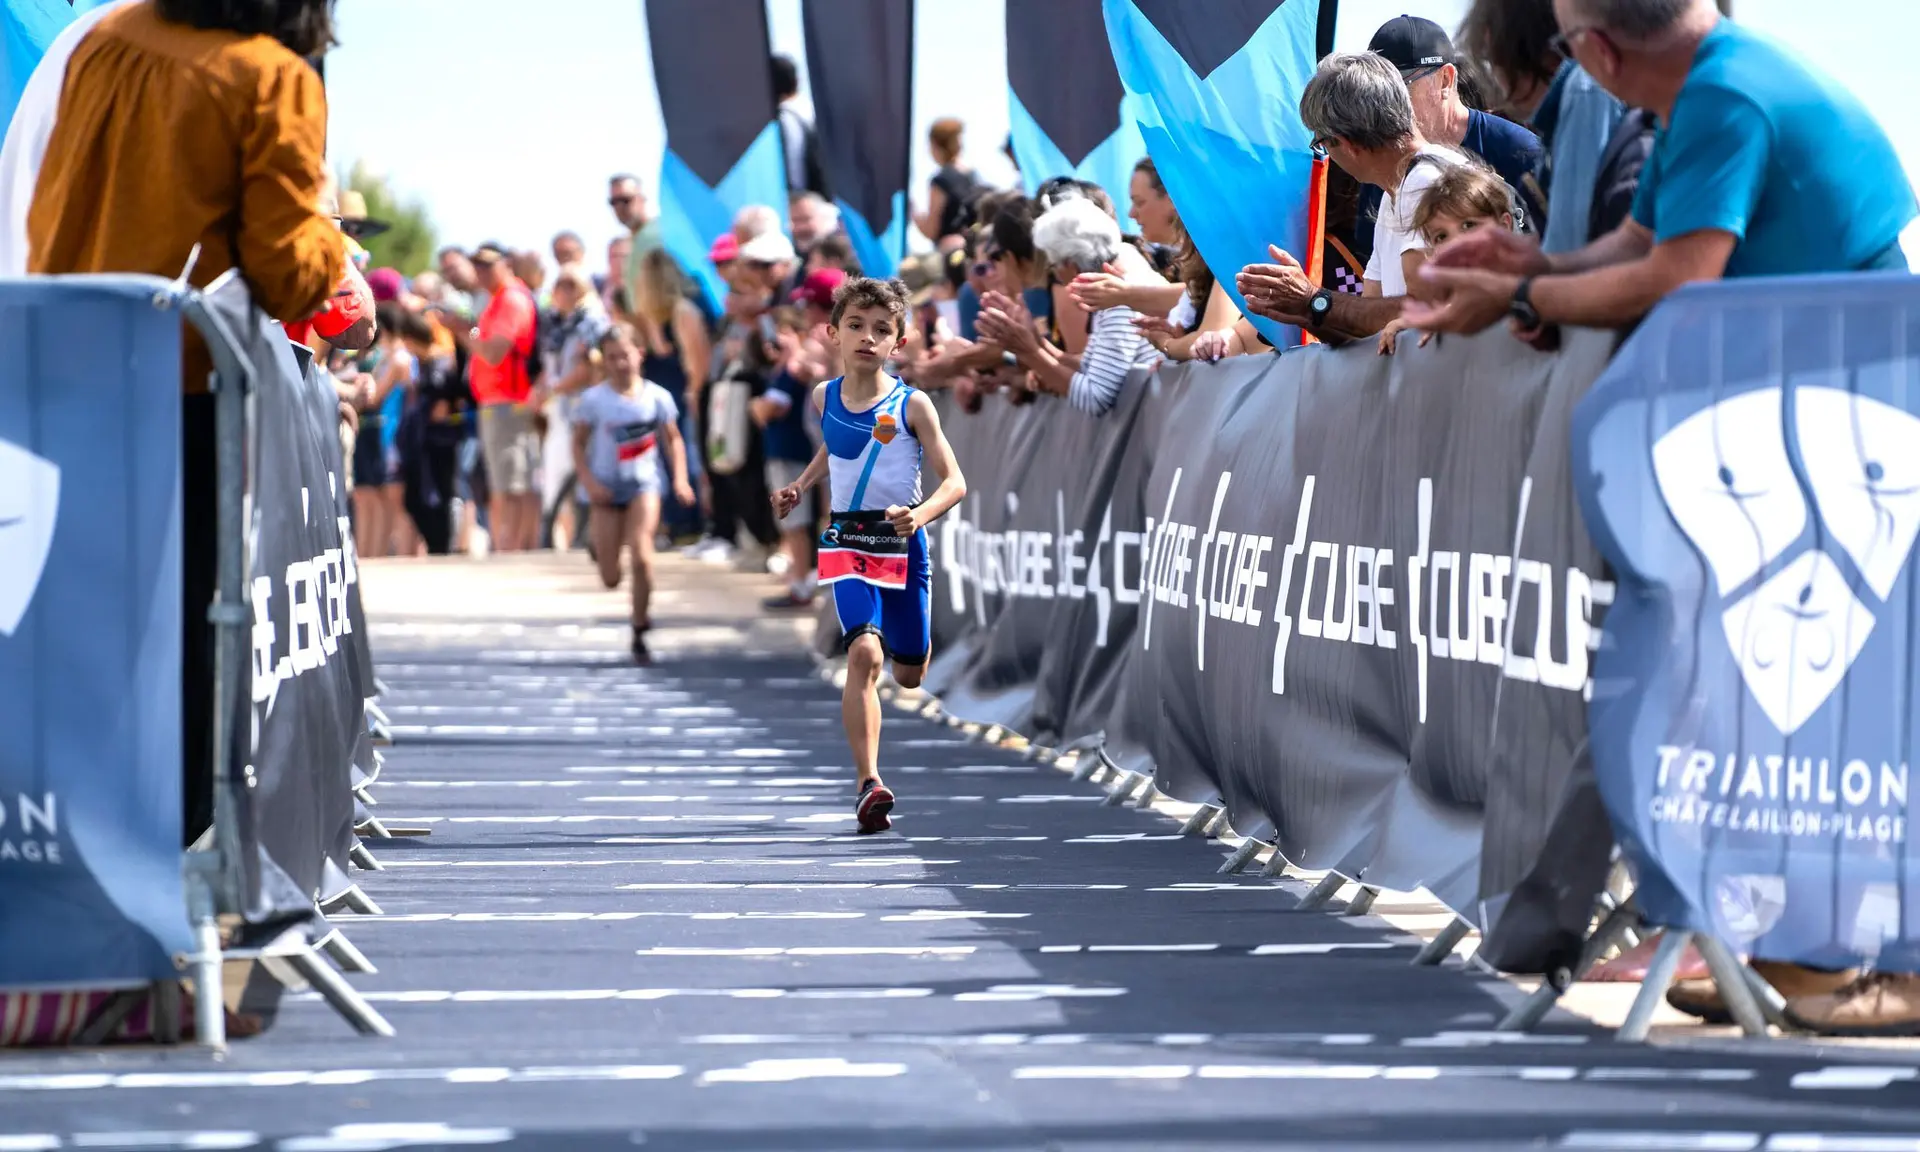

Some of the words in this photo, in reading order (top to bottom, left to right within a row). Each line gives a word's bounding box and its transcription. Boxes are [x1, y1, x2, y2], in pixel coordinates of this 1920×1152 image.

[853, 556, 867, 573] 3
[1209, 530, 1274, 627] CUBE
[1298, 541, 1397, 649] CUBE
[1430, 550, 1511, 667] CUBE
[1656, 746, 1908, 807] TRIATHLON
